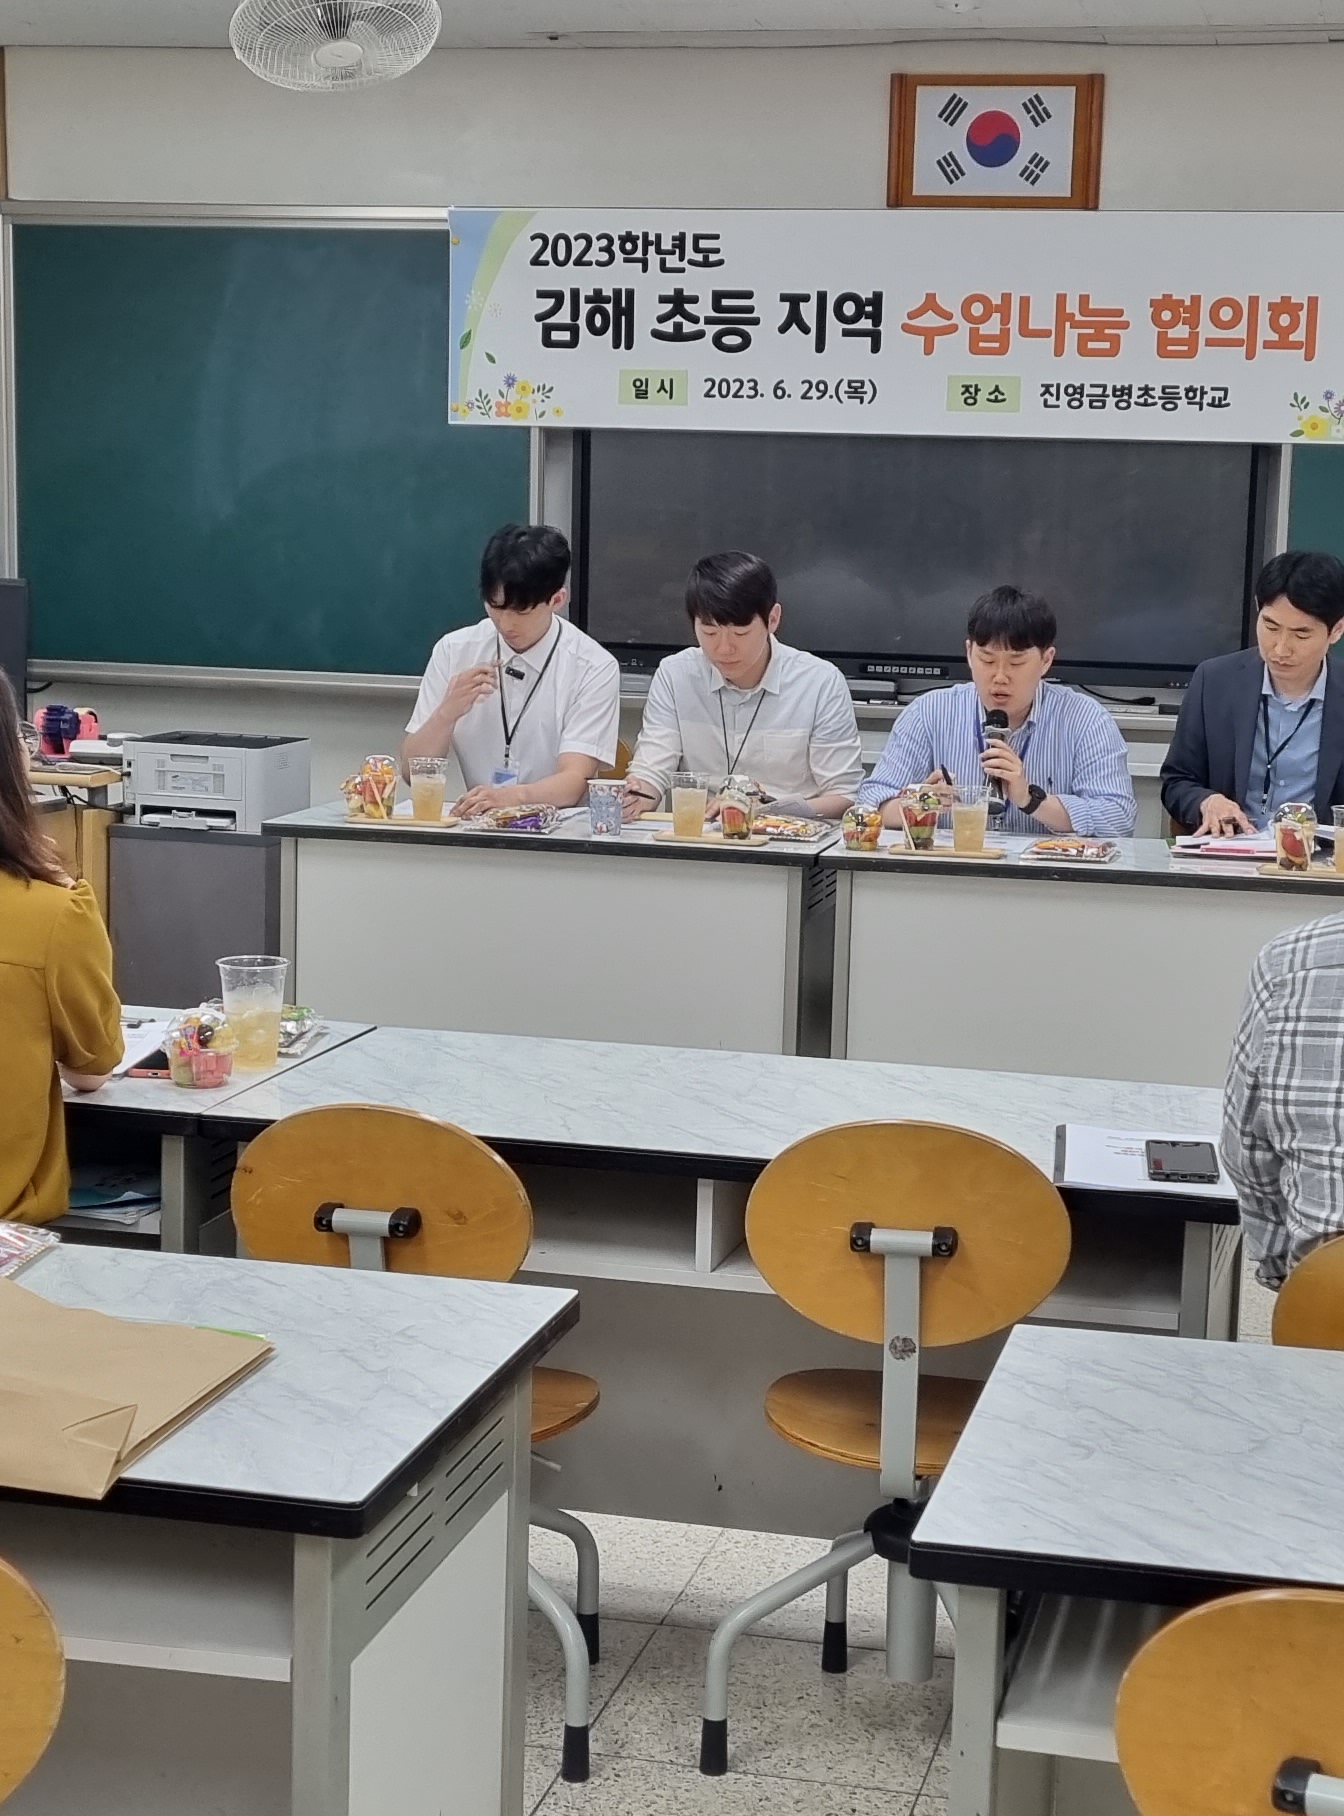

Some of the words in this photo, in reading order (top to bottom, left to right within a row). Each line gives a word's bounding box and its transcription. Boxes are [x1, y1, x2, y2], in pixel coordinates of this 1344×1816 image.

[529, 231, 725, 274] 2023학년도
[534, 287, 636, 351] 김해
[650, 287, 761, 354] 초등
[777, 290, 884, 355] 지역
[900, 292, 1131, 358] 수업나눔
[1149, 293, 1320, 362] 협의회
[703, 377, 764, 399] 2023.
[772, 379, 792, 399] 6.
[801, 378, 878, 405] 29.(목)
[1039, 382, 1232, 412] 진영금병초등학교
